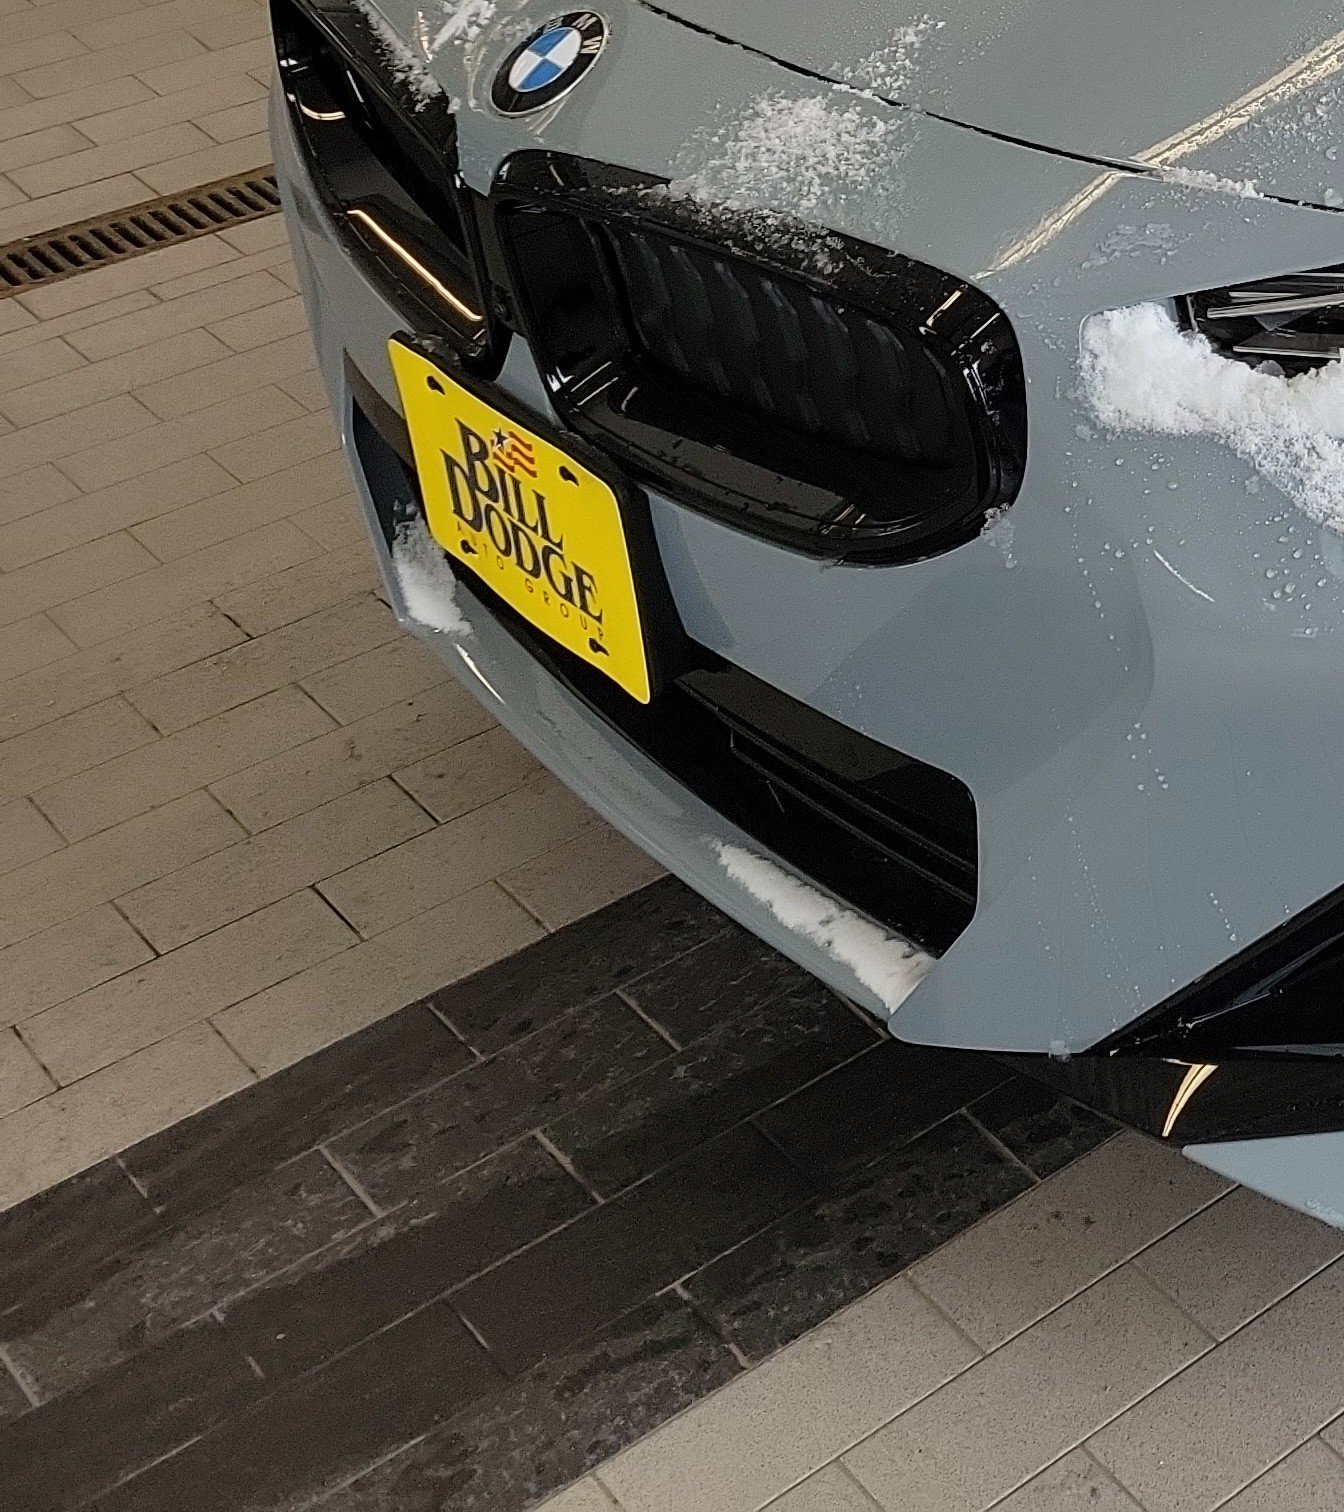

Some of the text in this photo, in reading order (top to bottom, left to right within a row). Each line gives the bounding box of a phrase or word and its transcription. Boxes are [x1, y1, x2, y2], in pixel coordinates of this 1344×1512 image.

[440, 449, 603, 625] DODGE
[455, 418, 564, 552] BILL
[524, 577, 604, 641] GROUP
